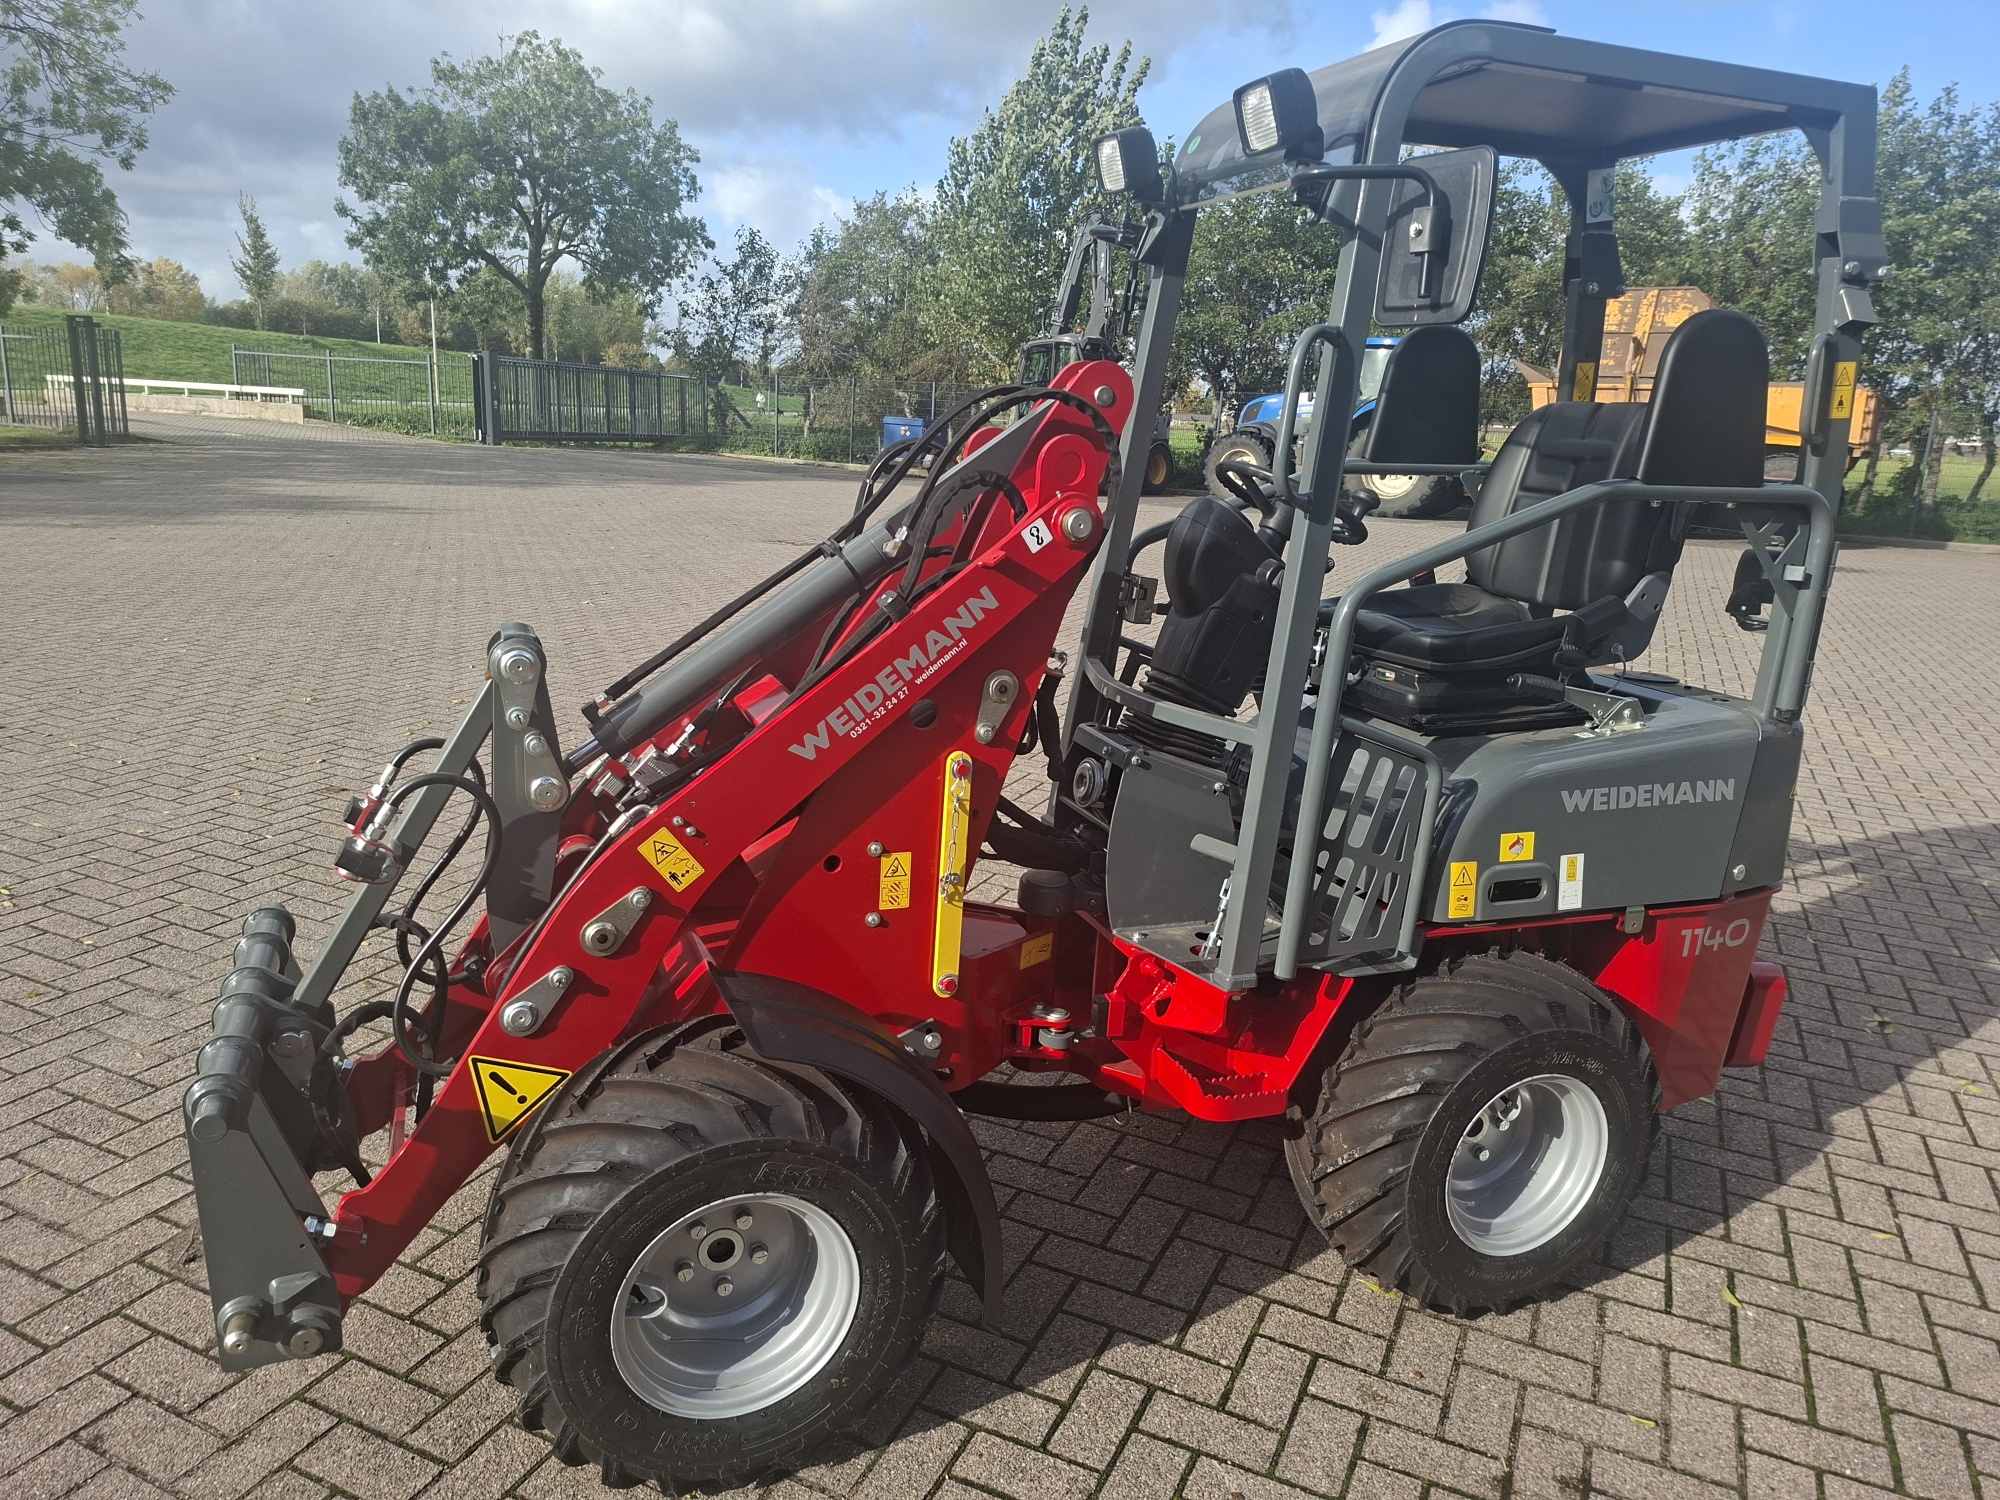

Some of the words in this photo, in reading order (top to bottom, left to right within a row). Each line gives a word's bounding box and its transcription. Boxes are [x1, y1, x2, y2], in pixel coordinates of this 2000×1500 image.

[788, 586, 999, 761] WEIDEMANN
[849, 706, 887, 739] 0321-32
[885, 696, 898, 710] 24
[897, 686, 909, 700] 27
[914, 638, 968, 685] weidemann.nl
[1560, 778, 1735, 813] WEIDEMANN
[1681, 918, 1750, 957] 1140
